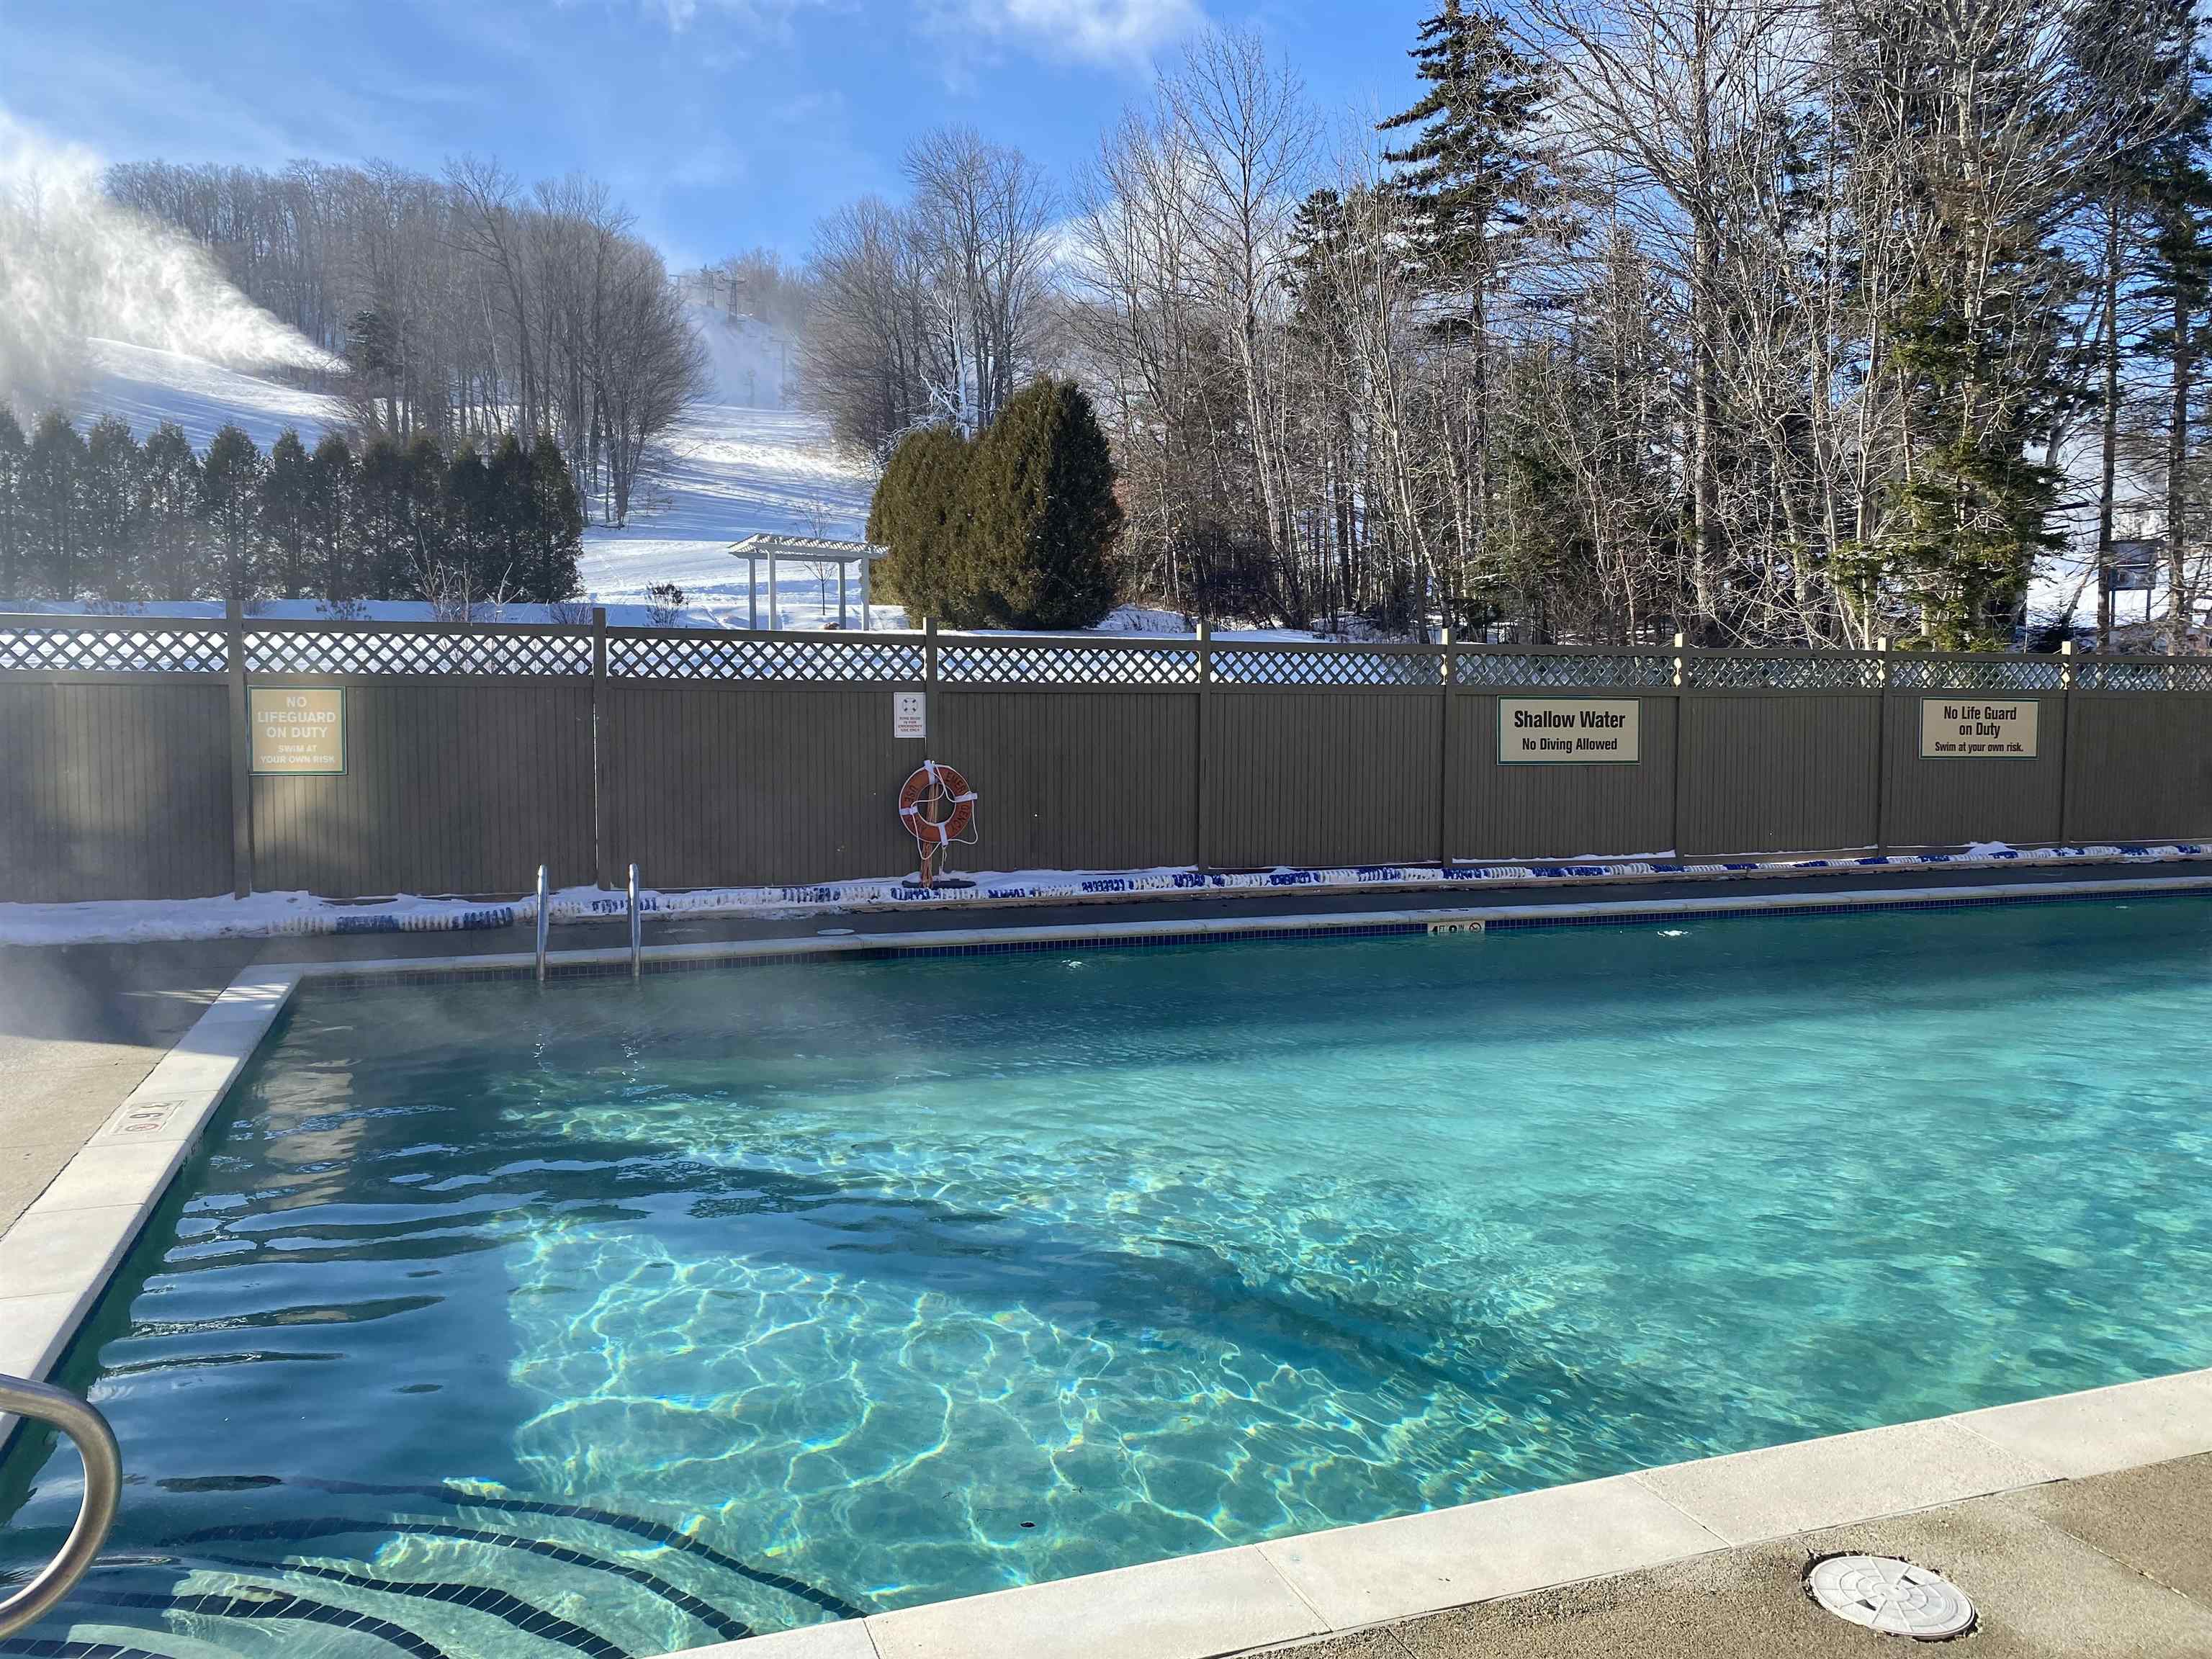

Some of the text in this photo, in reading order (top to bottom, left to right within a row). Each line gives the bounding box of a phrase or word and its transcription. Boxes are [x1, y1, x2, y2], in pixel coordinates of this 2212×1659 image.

[287, 696, 307, 708] NO
[258, 711, 336, 723] LIFEGUARD
[1514, 710, 1626, 728] Shallow Water
[1944, 706, 2017, 720] No Life Guard
[266, 727, 328, 738] ON DUTY
[1959, 722, 2001, 739] on Duty
[278, 745, 318, 753] SWIM AT
[1522, 737, 1618, 754] No Diving Allowed
[1935, 742, 1956, 752] Swim
[1959, 742, 1966, 752] at
[1968, 743, 1987, 754] your
[2006, 742, 2024, 752] risk.
[261, 755, 336, 764] YOUR OWN RISK
